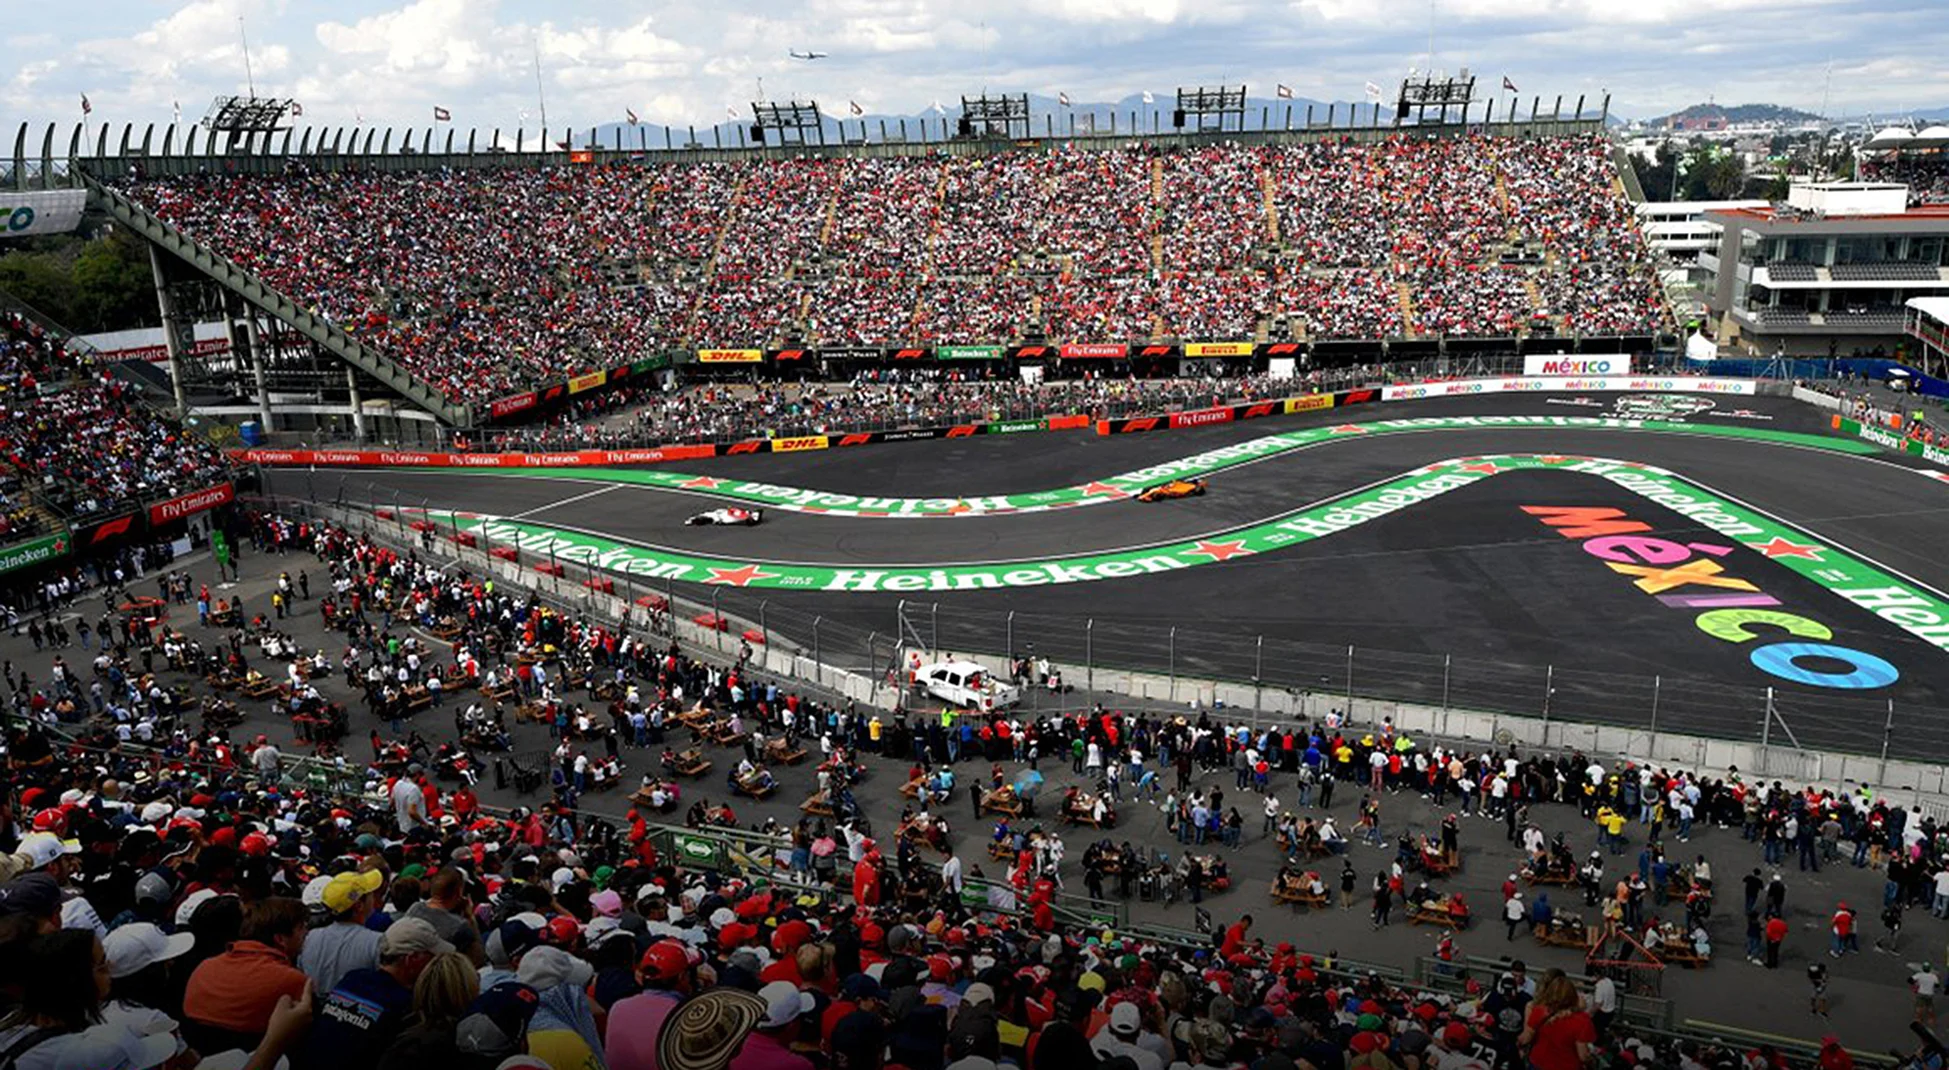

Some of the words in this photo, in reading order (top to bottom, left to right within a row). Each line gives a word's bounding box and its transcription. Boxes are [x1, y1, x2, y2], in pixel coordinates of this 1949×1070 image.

[781, 438, 819, 449] DHL
[162, 502, 181, 519] Fly
[180, 490, 225, 512] Emirates
[1276, 473, 1481, 539] Heineken
[820, 555, 1191, 592] Heineken
[321, 1003, 370, 1030] patagonia
[1471, 1042, 1497, 1070] 73
